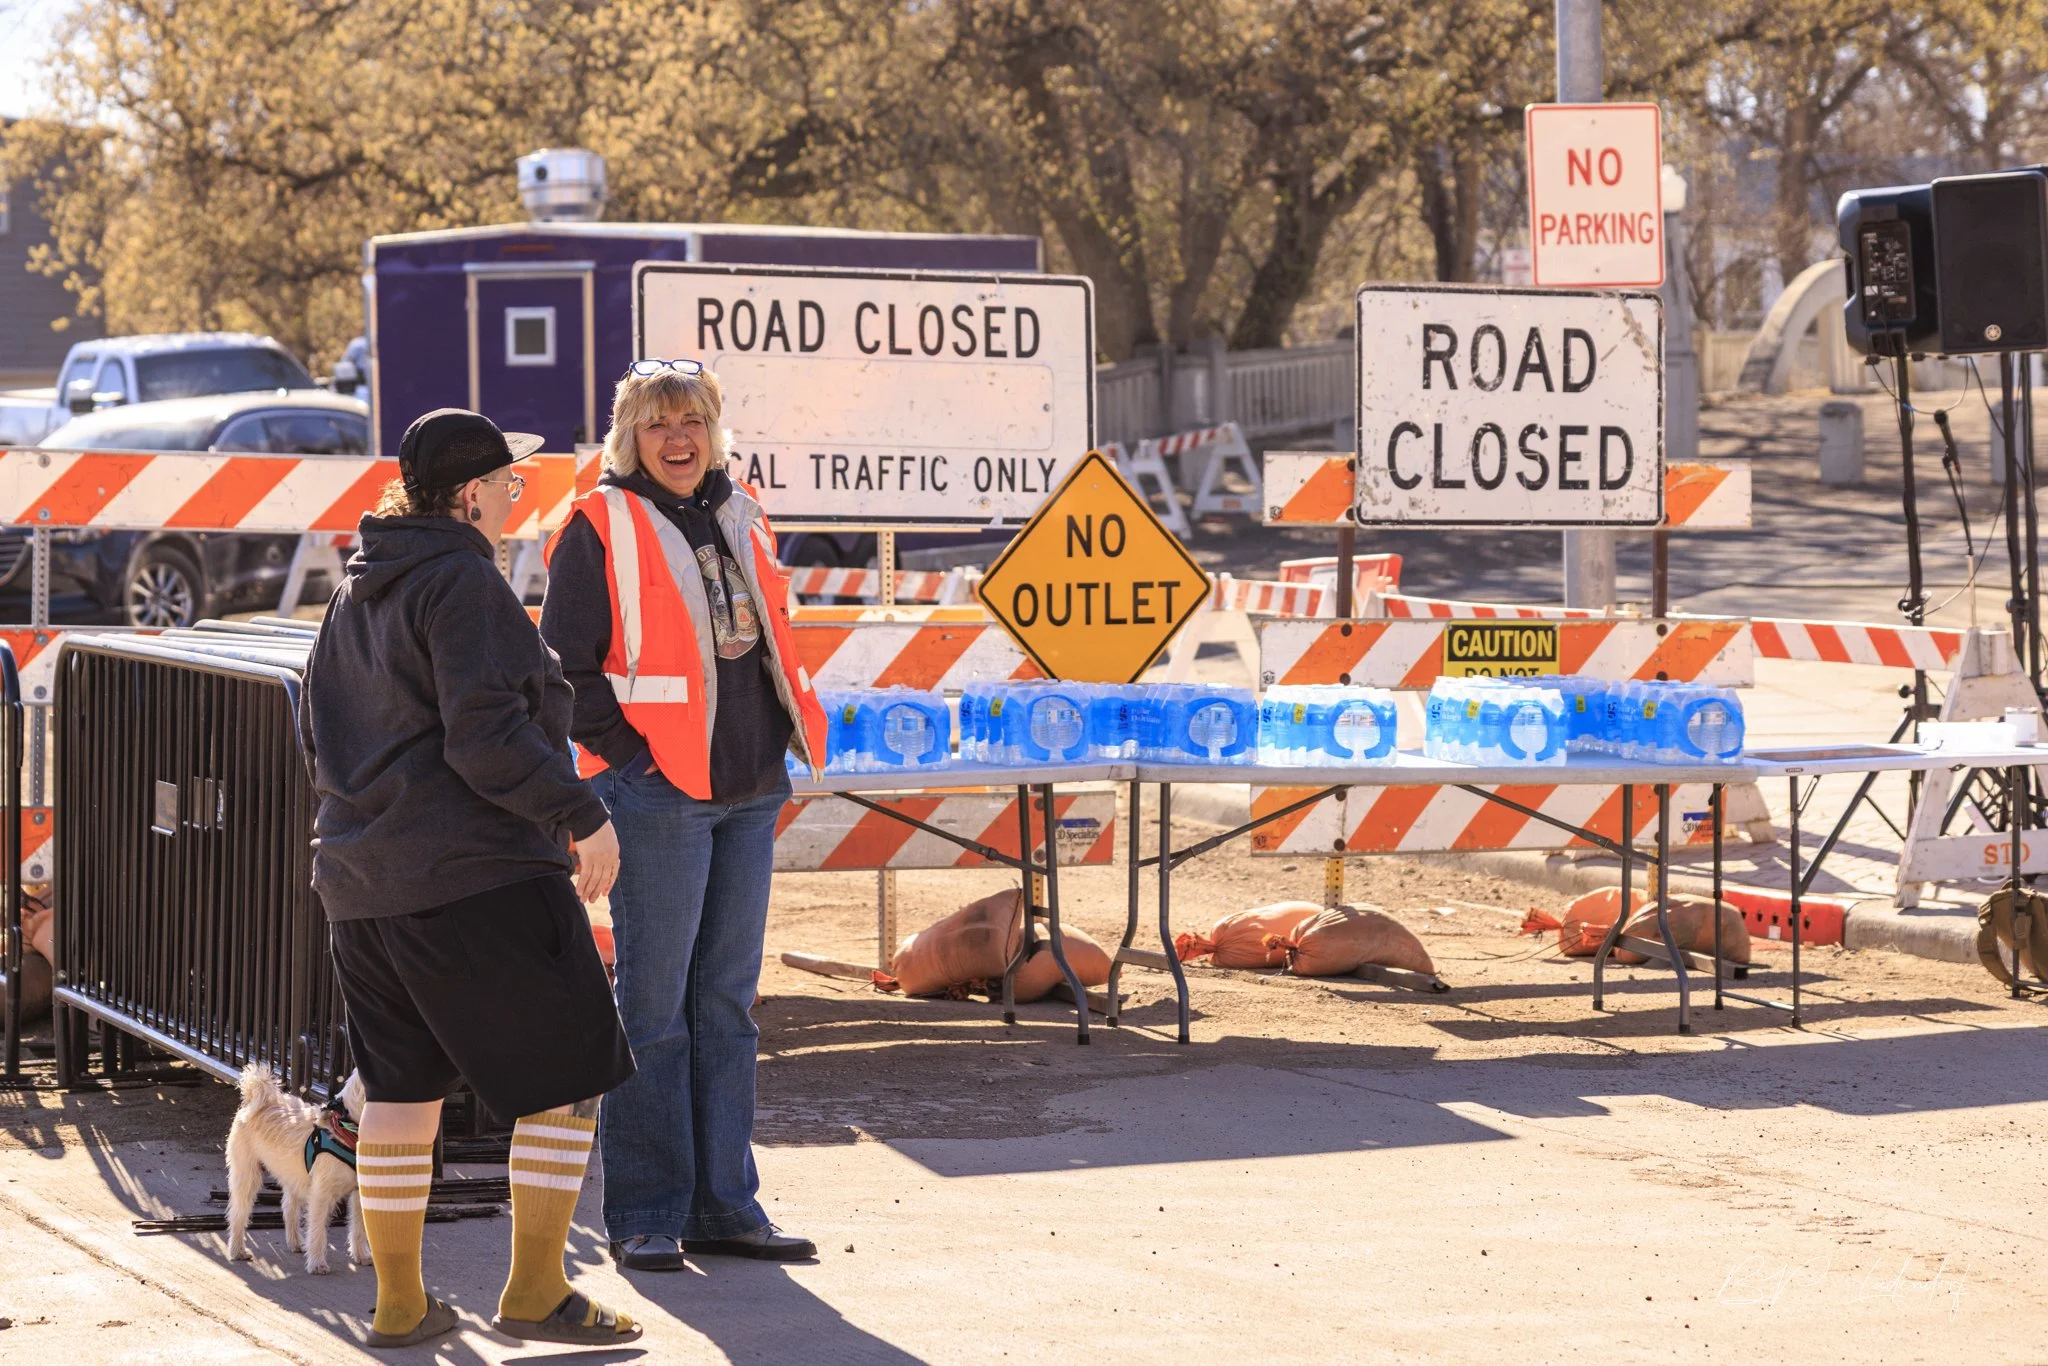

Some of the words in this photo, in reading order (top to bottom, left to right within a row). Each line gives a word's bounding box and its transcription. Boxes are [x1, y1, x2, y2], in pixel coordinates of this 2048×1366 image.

[1567, 148, 1623, 187] NO
[1540, 212, 1655, 246] PARKING
[698, 298, 825, 353] ROAD
[855, 302, 1041, 359] CLOSED
[1422, 323, 1597, 393] ROAD
[725, 452, 787, 489] CAL
[809, 454, 948, 492] TRAFFIC
[974, 457, 1057, 493] ONLY
[1387, 421, 1634, 491] CLOSED
[1066, 513, 1126, 558] NO
[1013, 581, 1181, 627] OUTLET
[1452, 629, 1553, 658] CAUTION
